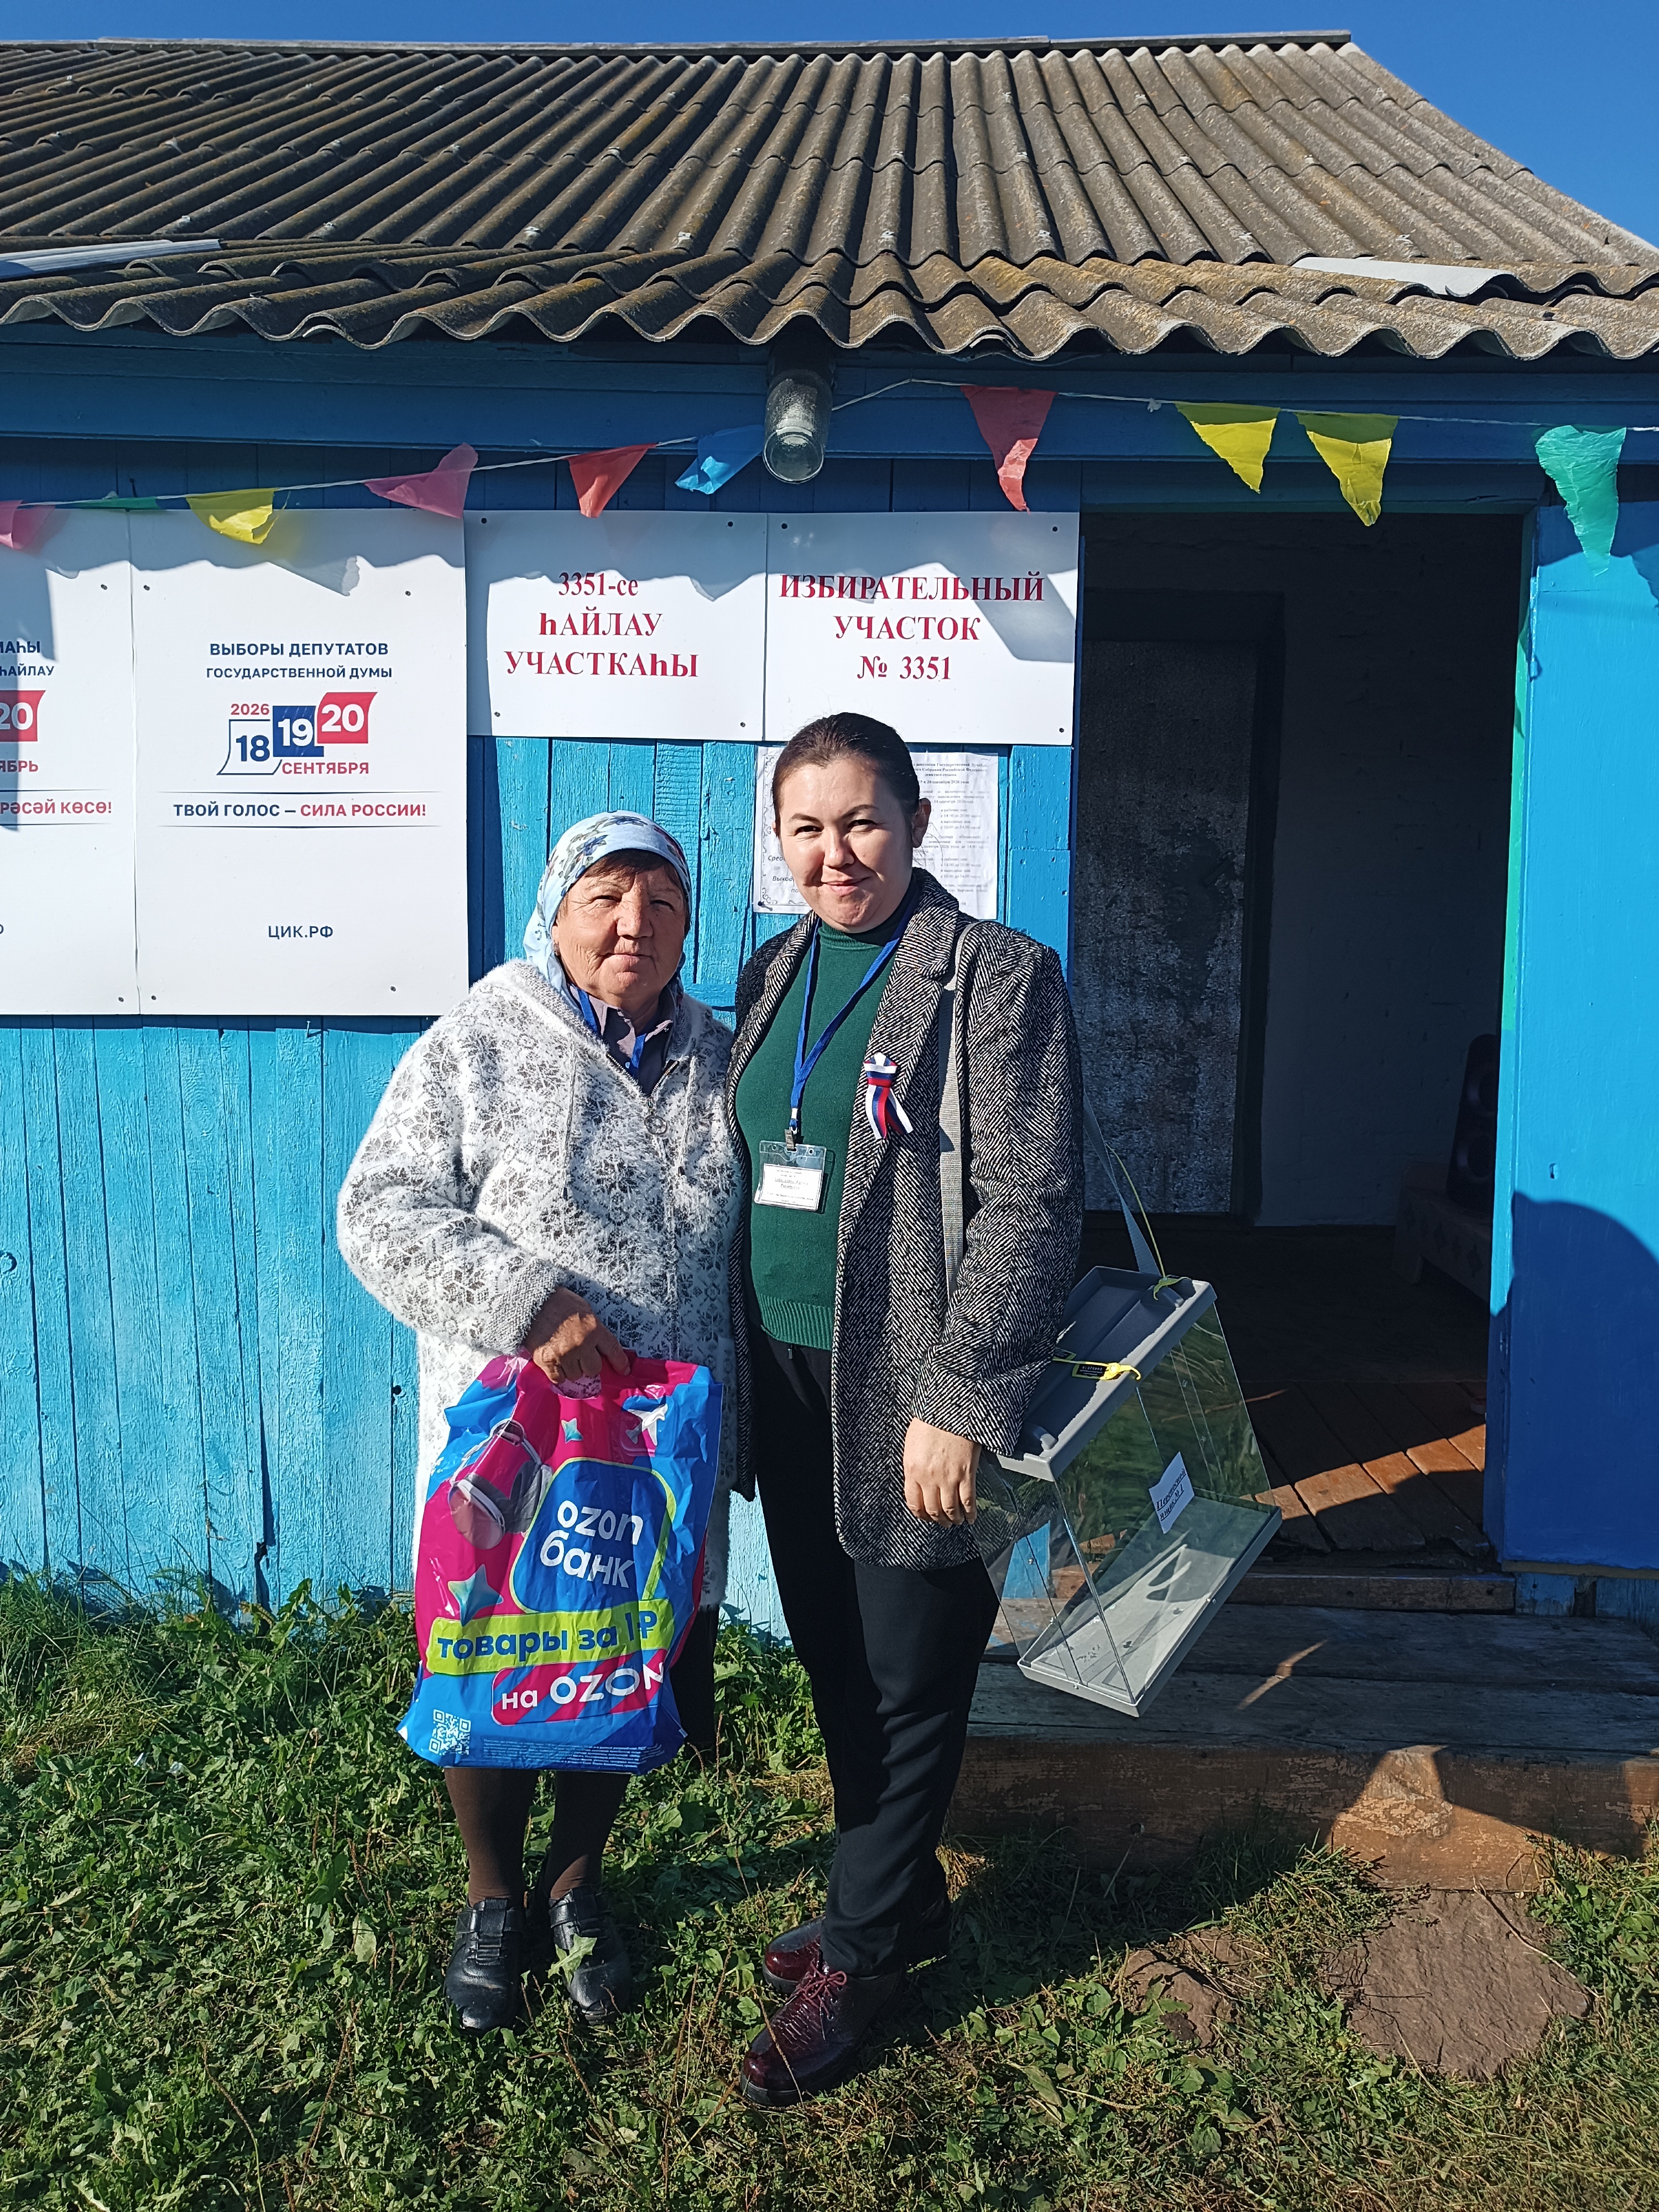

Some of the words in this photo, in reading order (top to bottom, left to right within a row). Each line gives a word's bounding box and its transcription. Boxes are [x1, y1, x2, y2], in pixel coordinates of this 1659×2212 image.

[558, 571, 638, 598] 3351-се
[780, 571, 1045, 602] ИЗБИРАТЕЛЬНЫЙ
[834, 615, 980, 641] УЧАСТОК
[210, 643, 284, 655] ВЫБОРЫ
[289, 643, 389, 658] ДЕПУТАТОВ
[206, 665, 346, 680] ГОСУДАРСТВЕННОЙ
[349, 667, 393, 680] ДУМЫ
[857, 656, 888, 679] №
[900, 656, 951, 680] 3351
[231, 703, 270, 716] 2026
[321, 703, 365, 733] 20
[278, 718, 314, 747] 19
[236, 735, 270, 762] 18
[282, 763, 369, 774] СЕНТЯБРЯ
[61, 801, 112, 814] КӨСӨ!
[173, 801, 219, 816] ТВОЙ
[224, 804, 280, 817] ГОЛОС
[301, 804, 347, 817] СИЛА
[352, 804, 427, 817] РОССИИ!
[268, 925, 334, 940] ЦИК.РФ
[1156, 1468, 1186, 1510] Переносной
[557, 1500, 643, 1545] ozon
[1160, 1499, 1175, 1520] ящик
[540, 1530, 635, 1588] банк
[437, 1630, 568, 1662] товары
[578, 1625, 618, 1650] за
[502, 1689, 538, 1710] на
[550, 1661, 664, 1704] OZON
